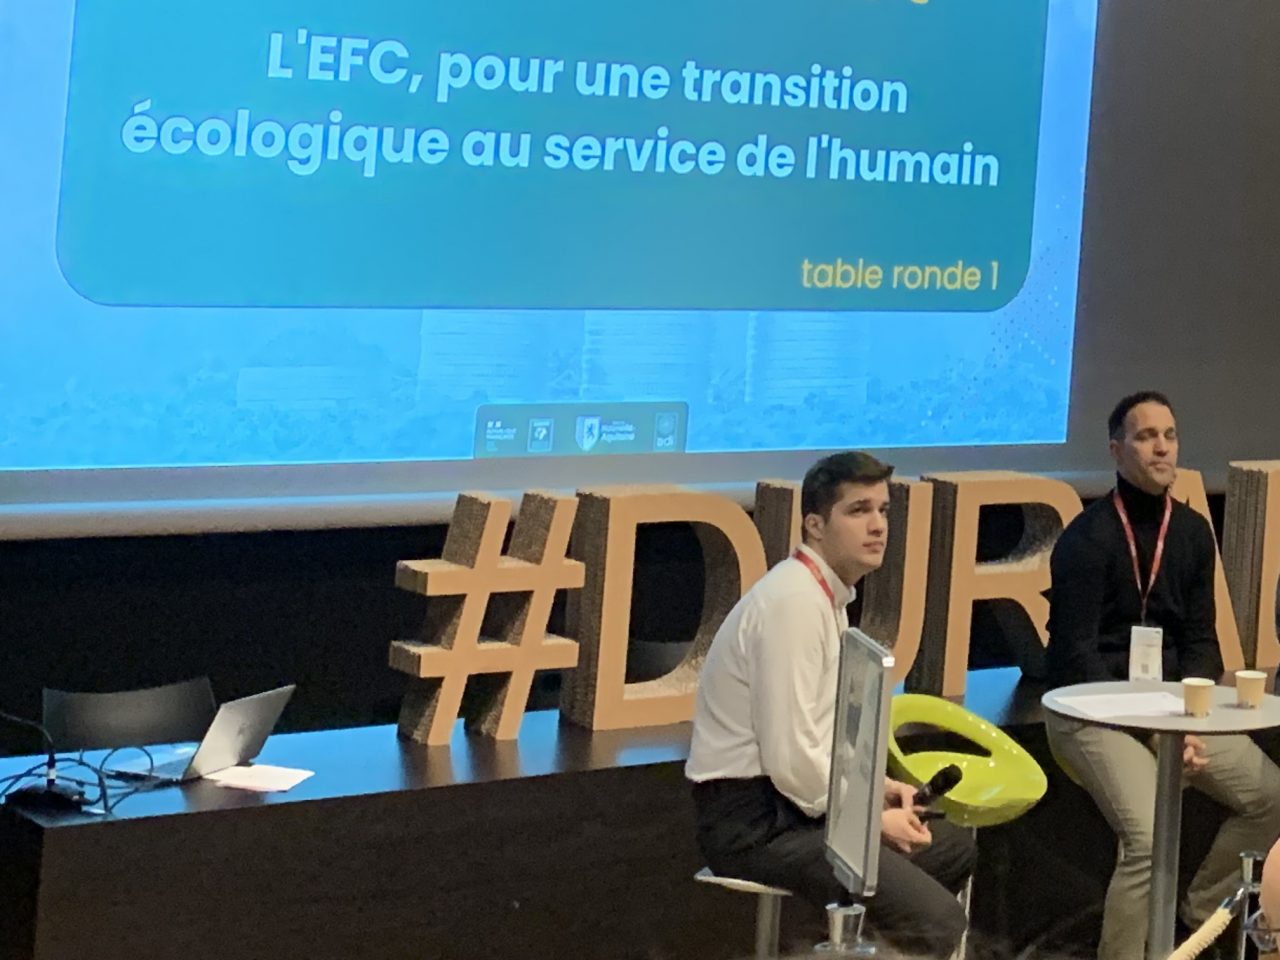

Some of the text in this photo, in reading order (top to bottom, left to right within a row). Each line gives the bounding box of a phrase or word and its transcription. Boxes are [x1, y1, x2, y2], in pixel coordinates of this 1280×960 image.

[266, 27, 909, 114] L'EFC, pour une transition
[120, 97, 1000, 187] écologique au service de l'humain
[801, 257, 1000, 293] table ronde 1
